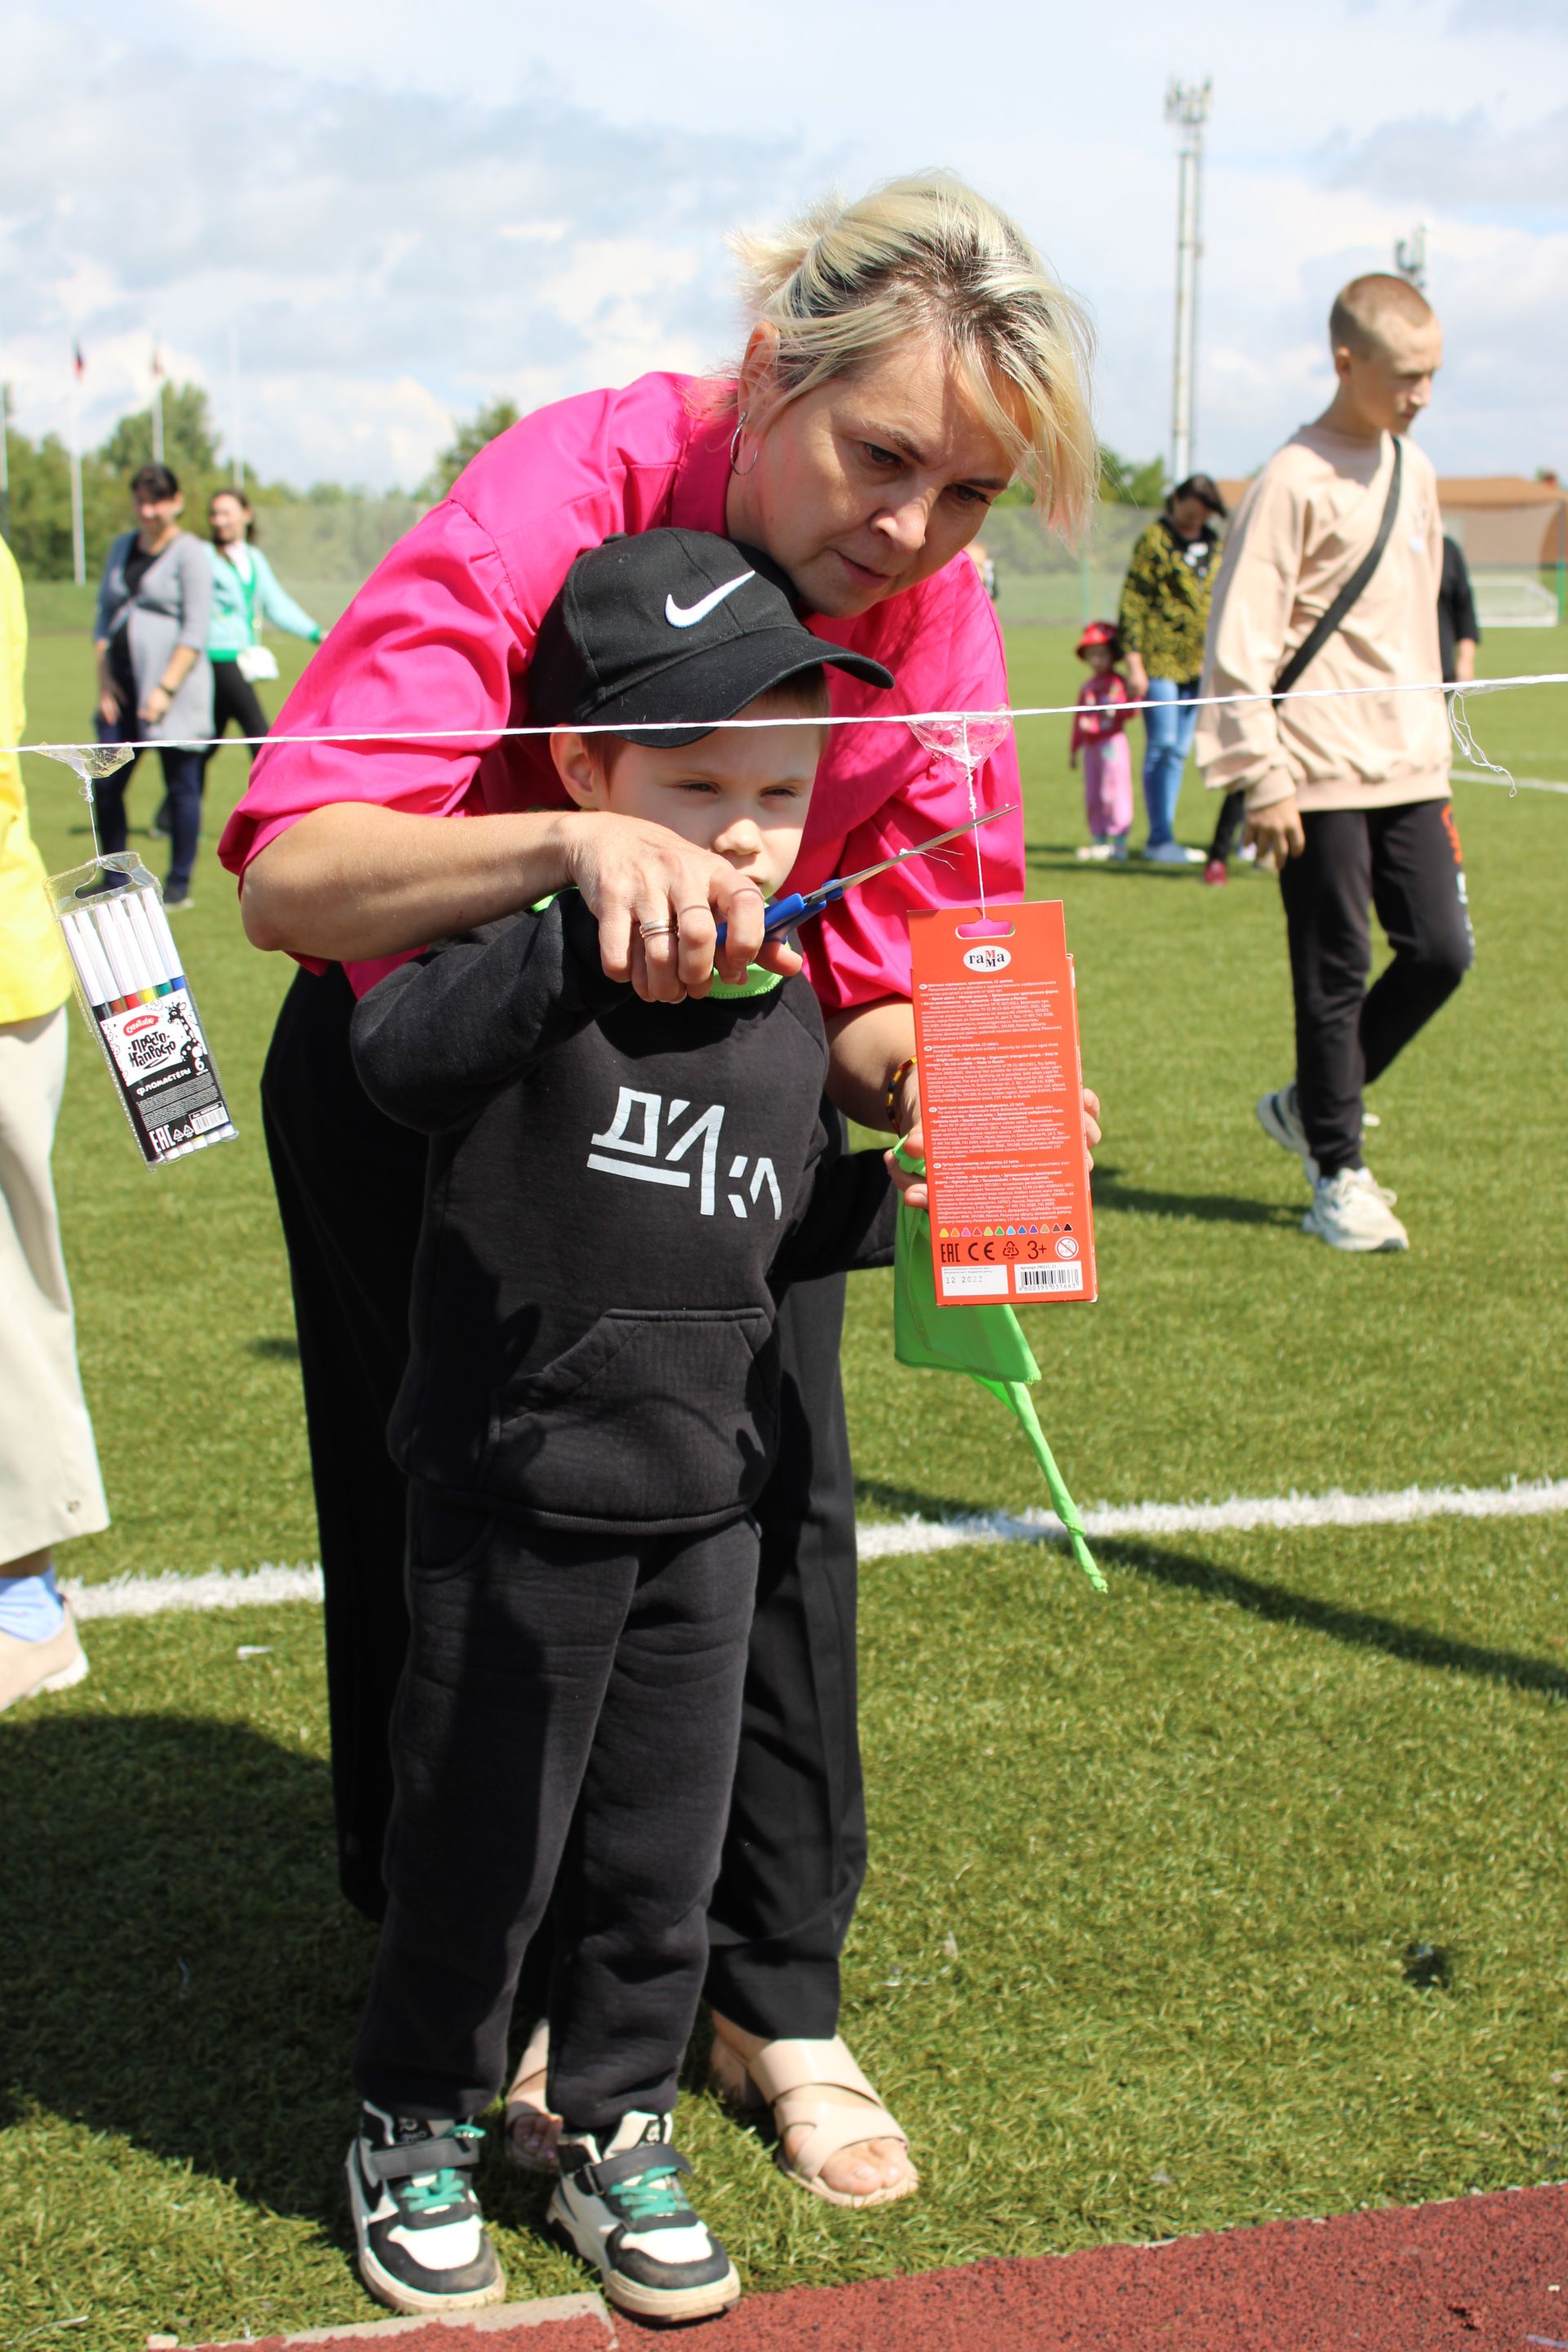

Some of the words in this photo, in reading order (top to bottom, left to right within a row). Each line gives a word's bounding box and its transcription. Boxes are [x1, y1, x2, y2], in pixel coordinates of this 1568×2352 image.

[194, 1058, 205, 1071] 6
[1027, 1241, 1047, 1259] 3+
[946, 1276, 956, 1285] 12
